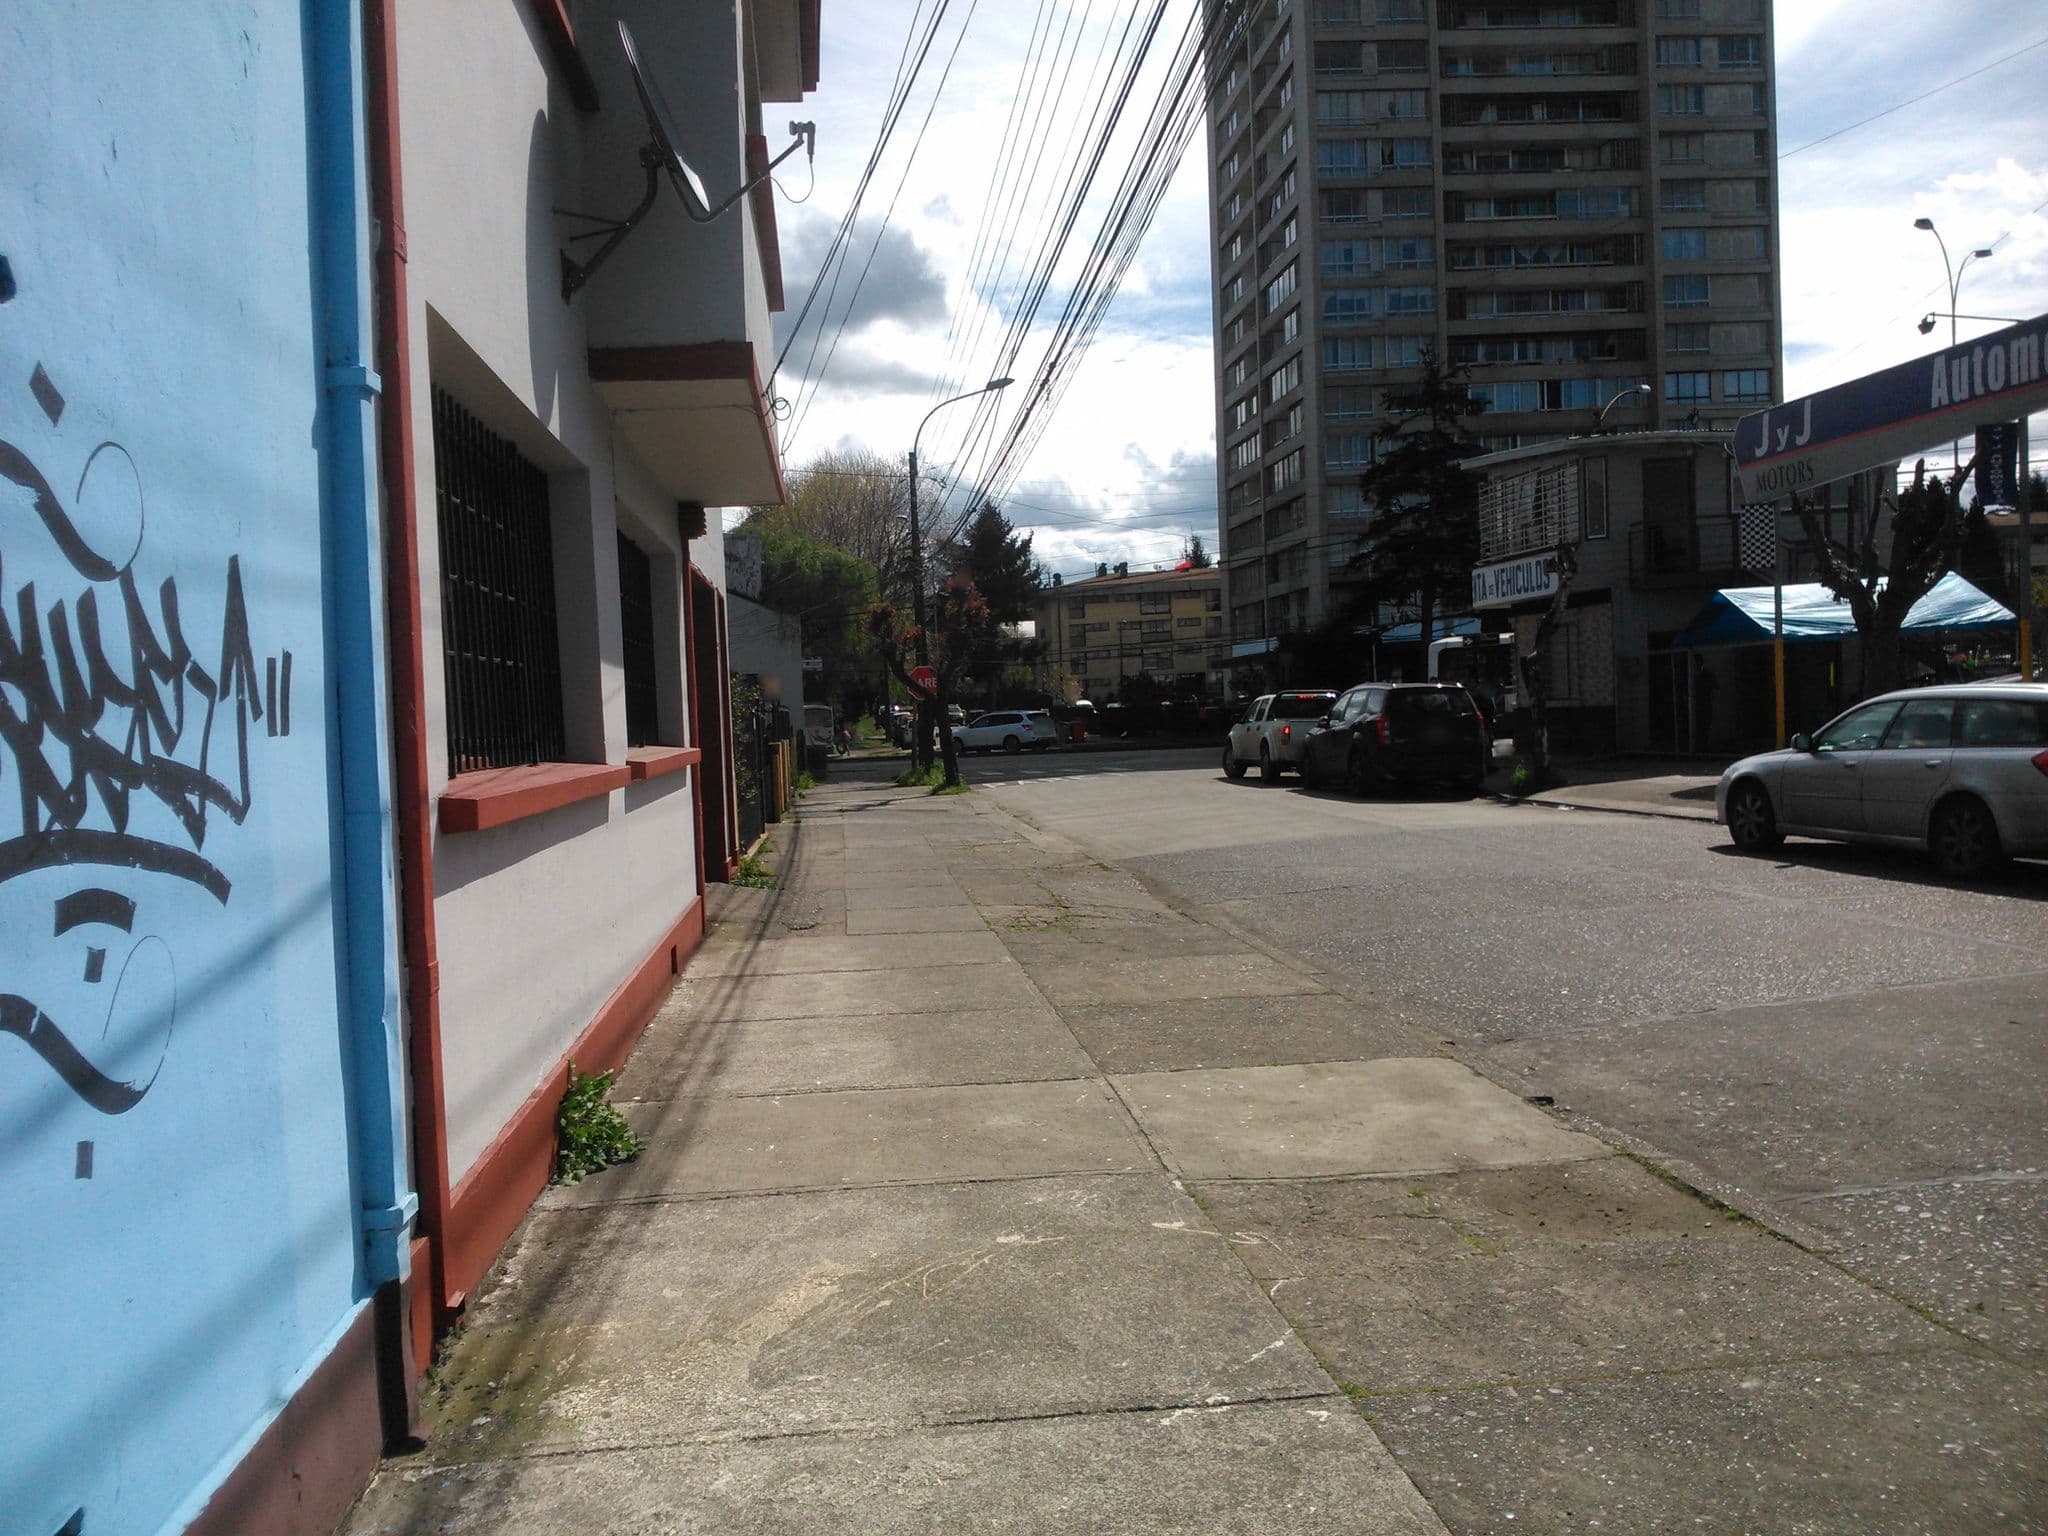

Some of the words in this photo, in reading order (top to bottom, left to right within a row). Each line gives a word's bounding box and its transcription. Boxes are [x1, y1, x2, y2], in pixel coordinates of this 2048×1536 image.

[1755, 411, 1769, 458] J
[1776, 425, 1790, 452] y
[1795, 399, 1811, 446] J
[1756, 460, 1814, 491] MOTORS
[1495, 559, 1551, 600] VEHICULOS
[917, 677, 937, 688] ARE
